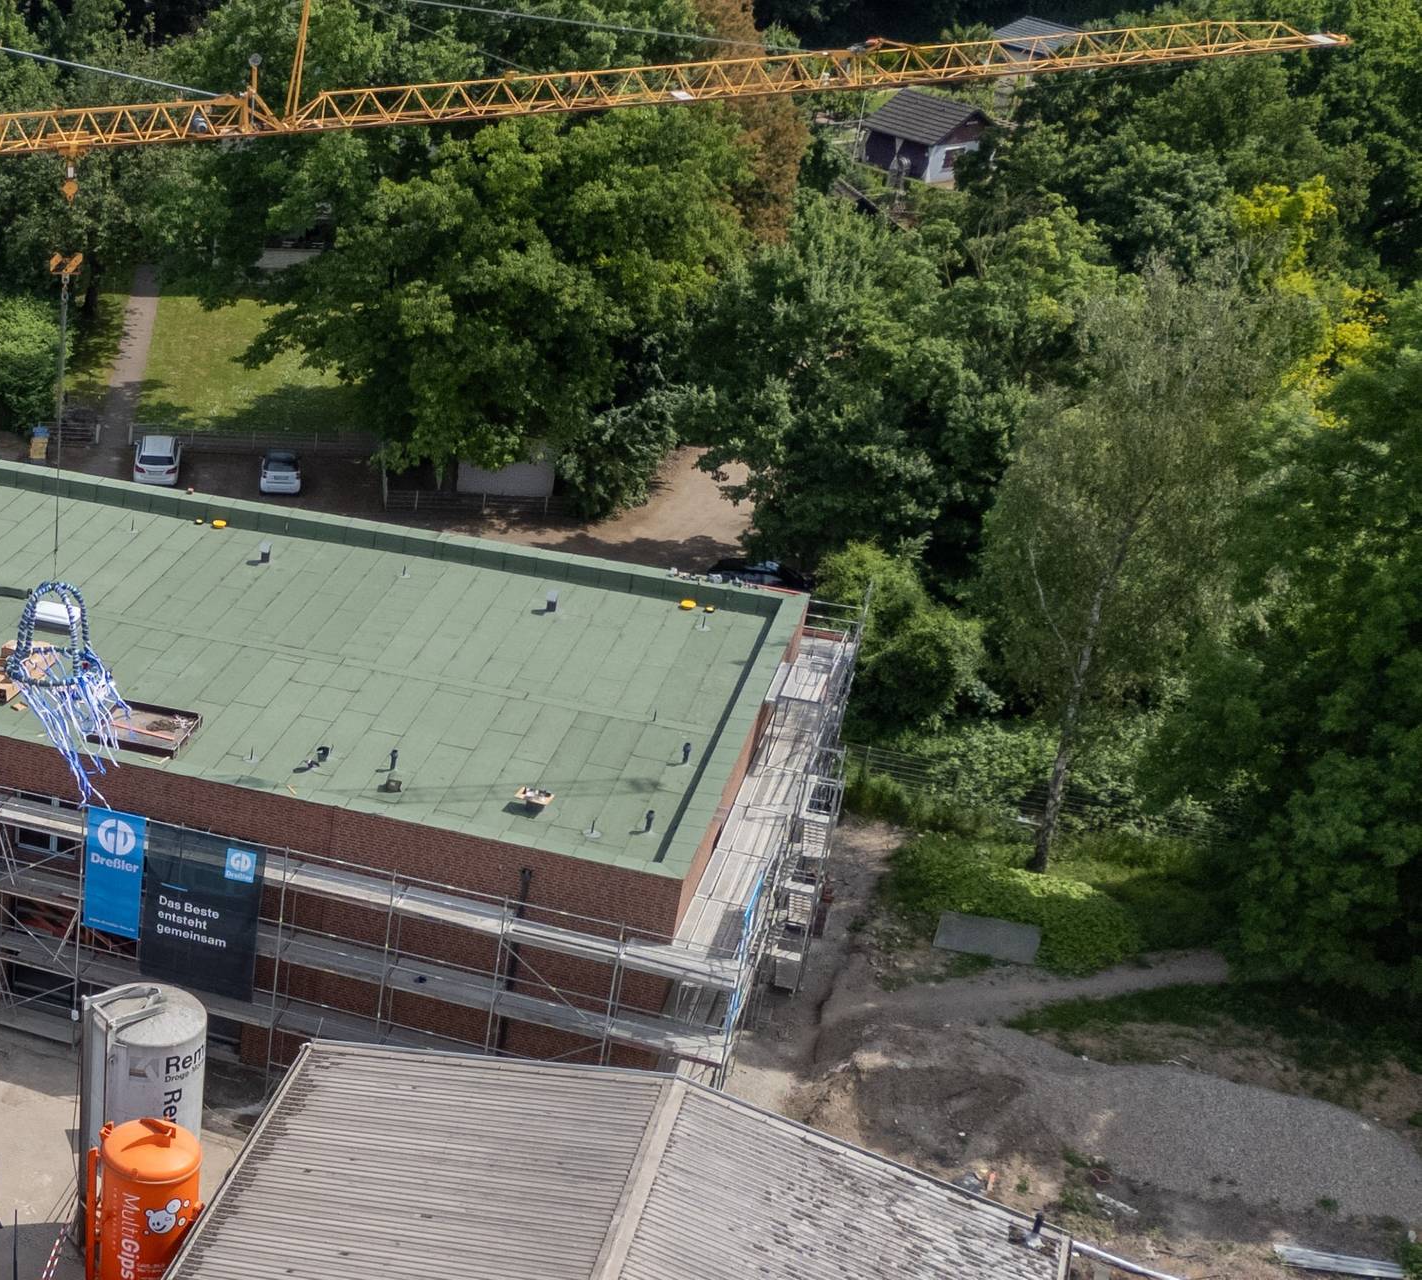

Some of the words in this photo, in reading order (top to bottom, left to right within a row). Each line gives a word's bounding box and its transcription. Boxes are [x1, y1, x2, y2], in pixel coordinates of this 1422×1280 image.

[90, 852, 139, 873] Dreßler
[159, 895, 181, 910] Das
[184, 902, 220, 919] Beste
[158, 910, 208, 930] entsteht
[156, 924, 227, 948] gemeinsam
[117, 1192, 141, 1280] MultiGips
